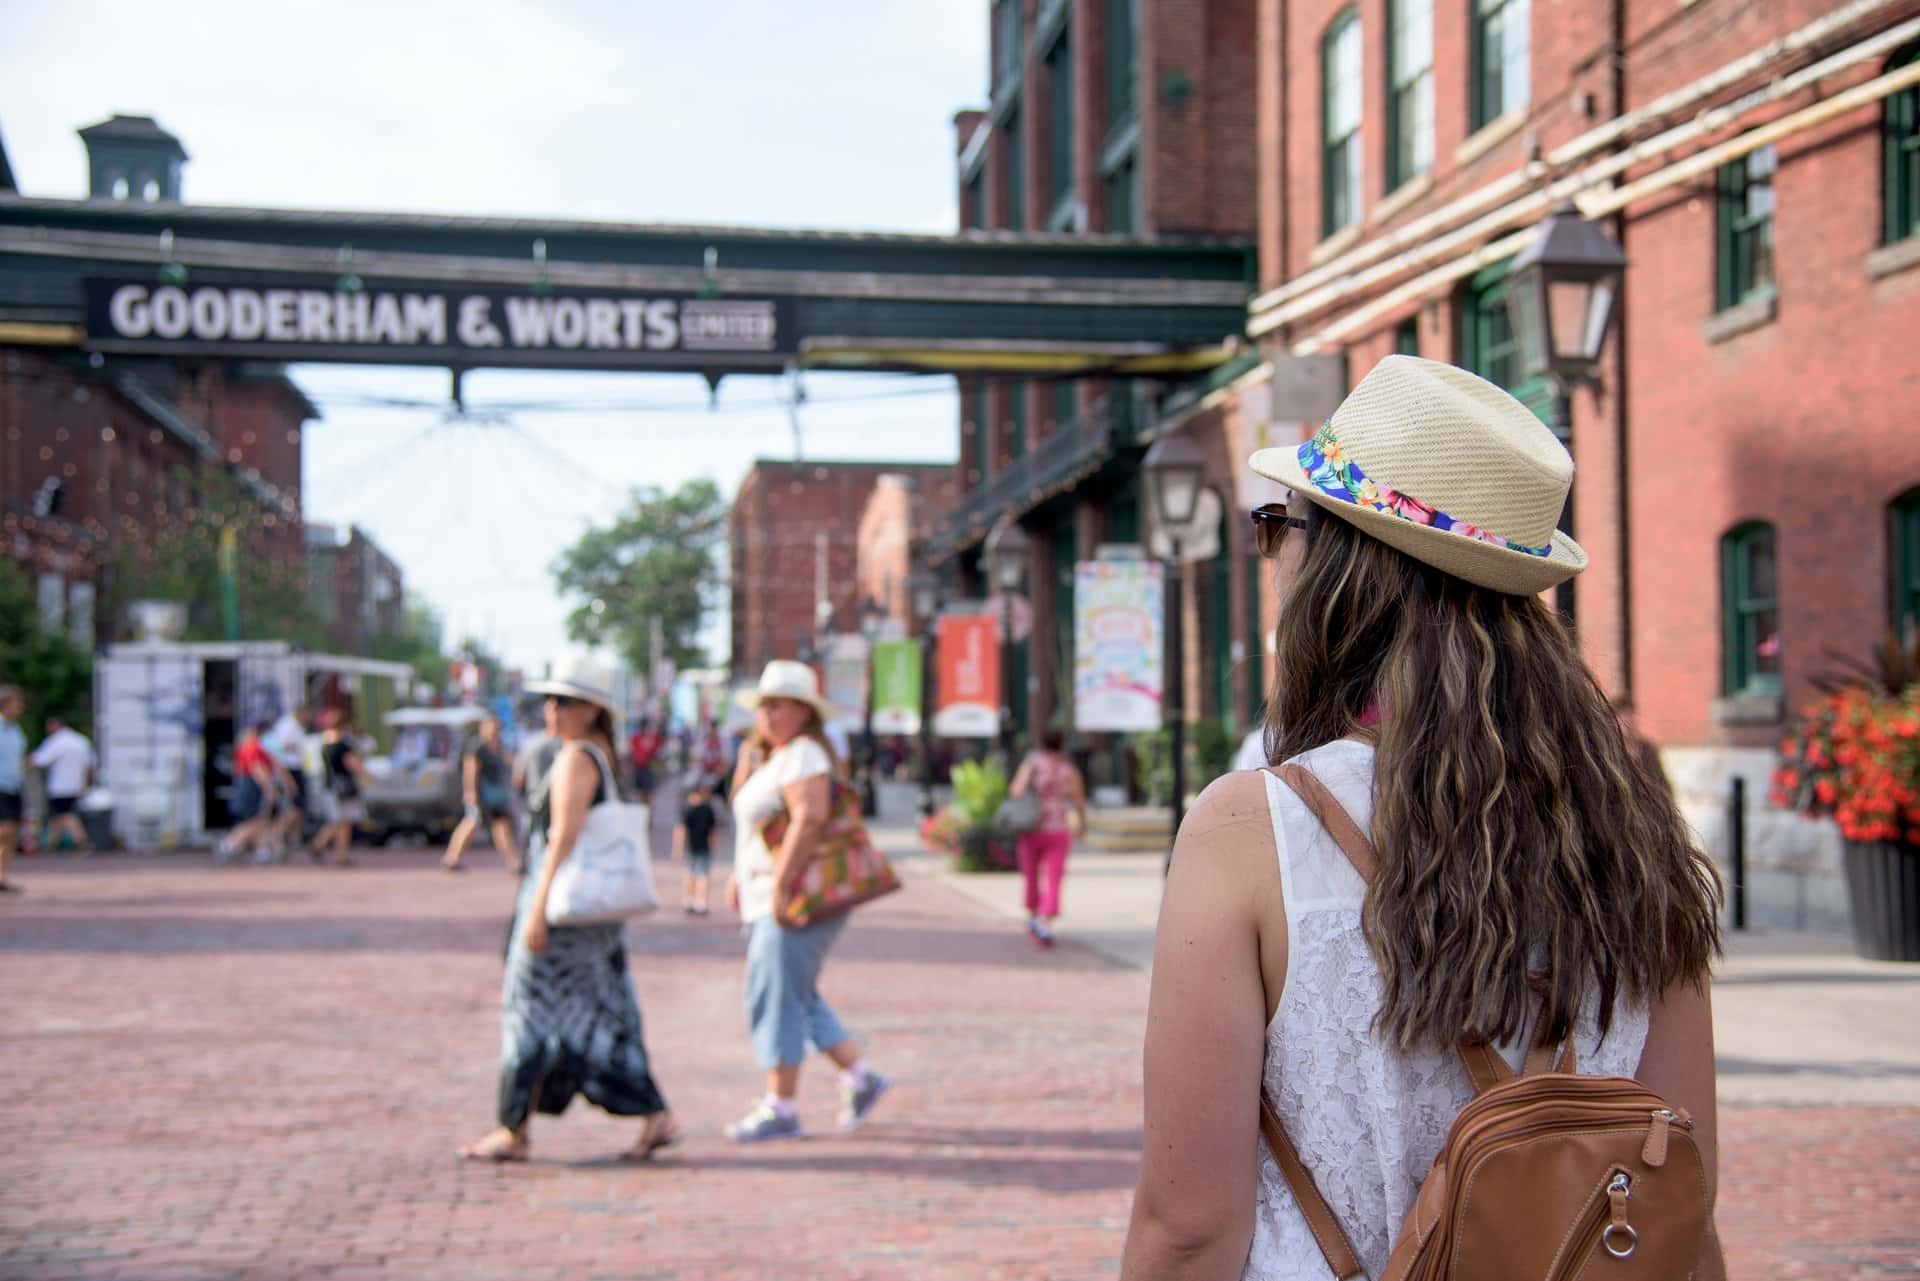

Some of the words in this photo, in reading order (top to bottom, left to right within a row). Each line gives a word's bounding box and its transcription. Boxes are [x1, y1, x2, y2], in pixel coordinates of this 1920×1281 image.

[109, 284, 447, 344] GOODERHAM
[457, 296, 502, 347] &
[506, 299, 679, 350] WORTS
